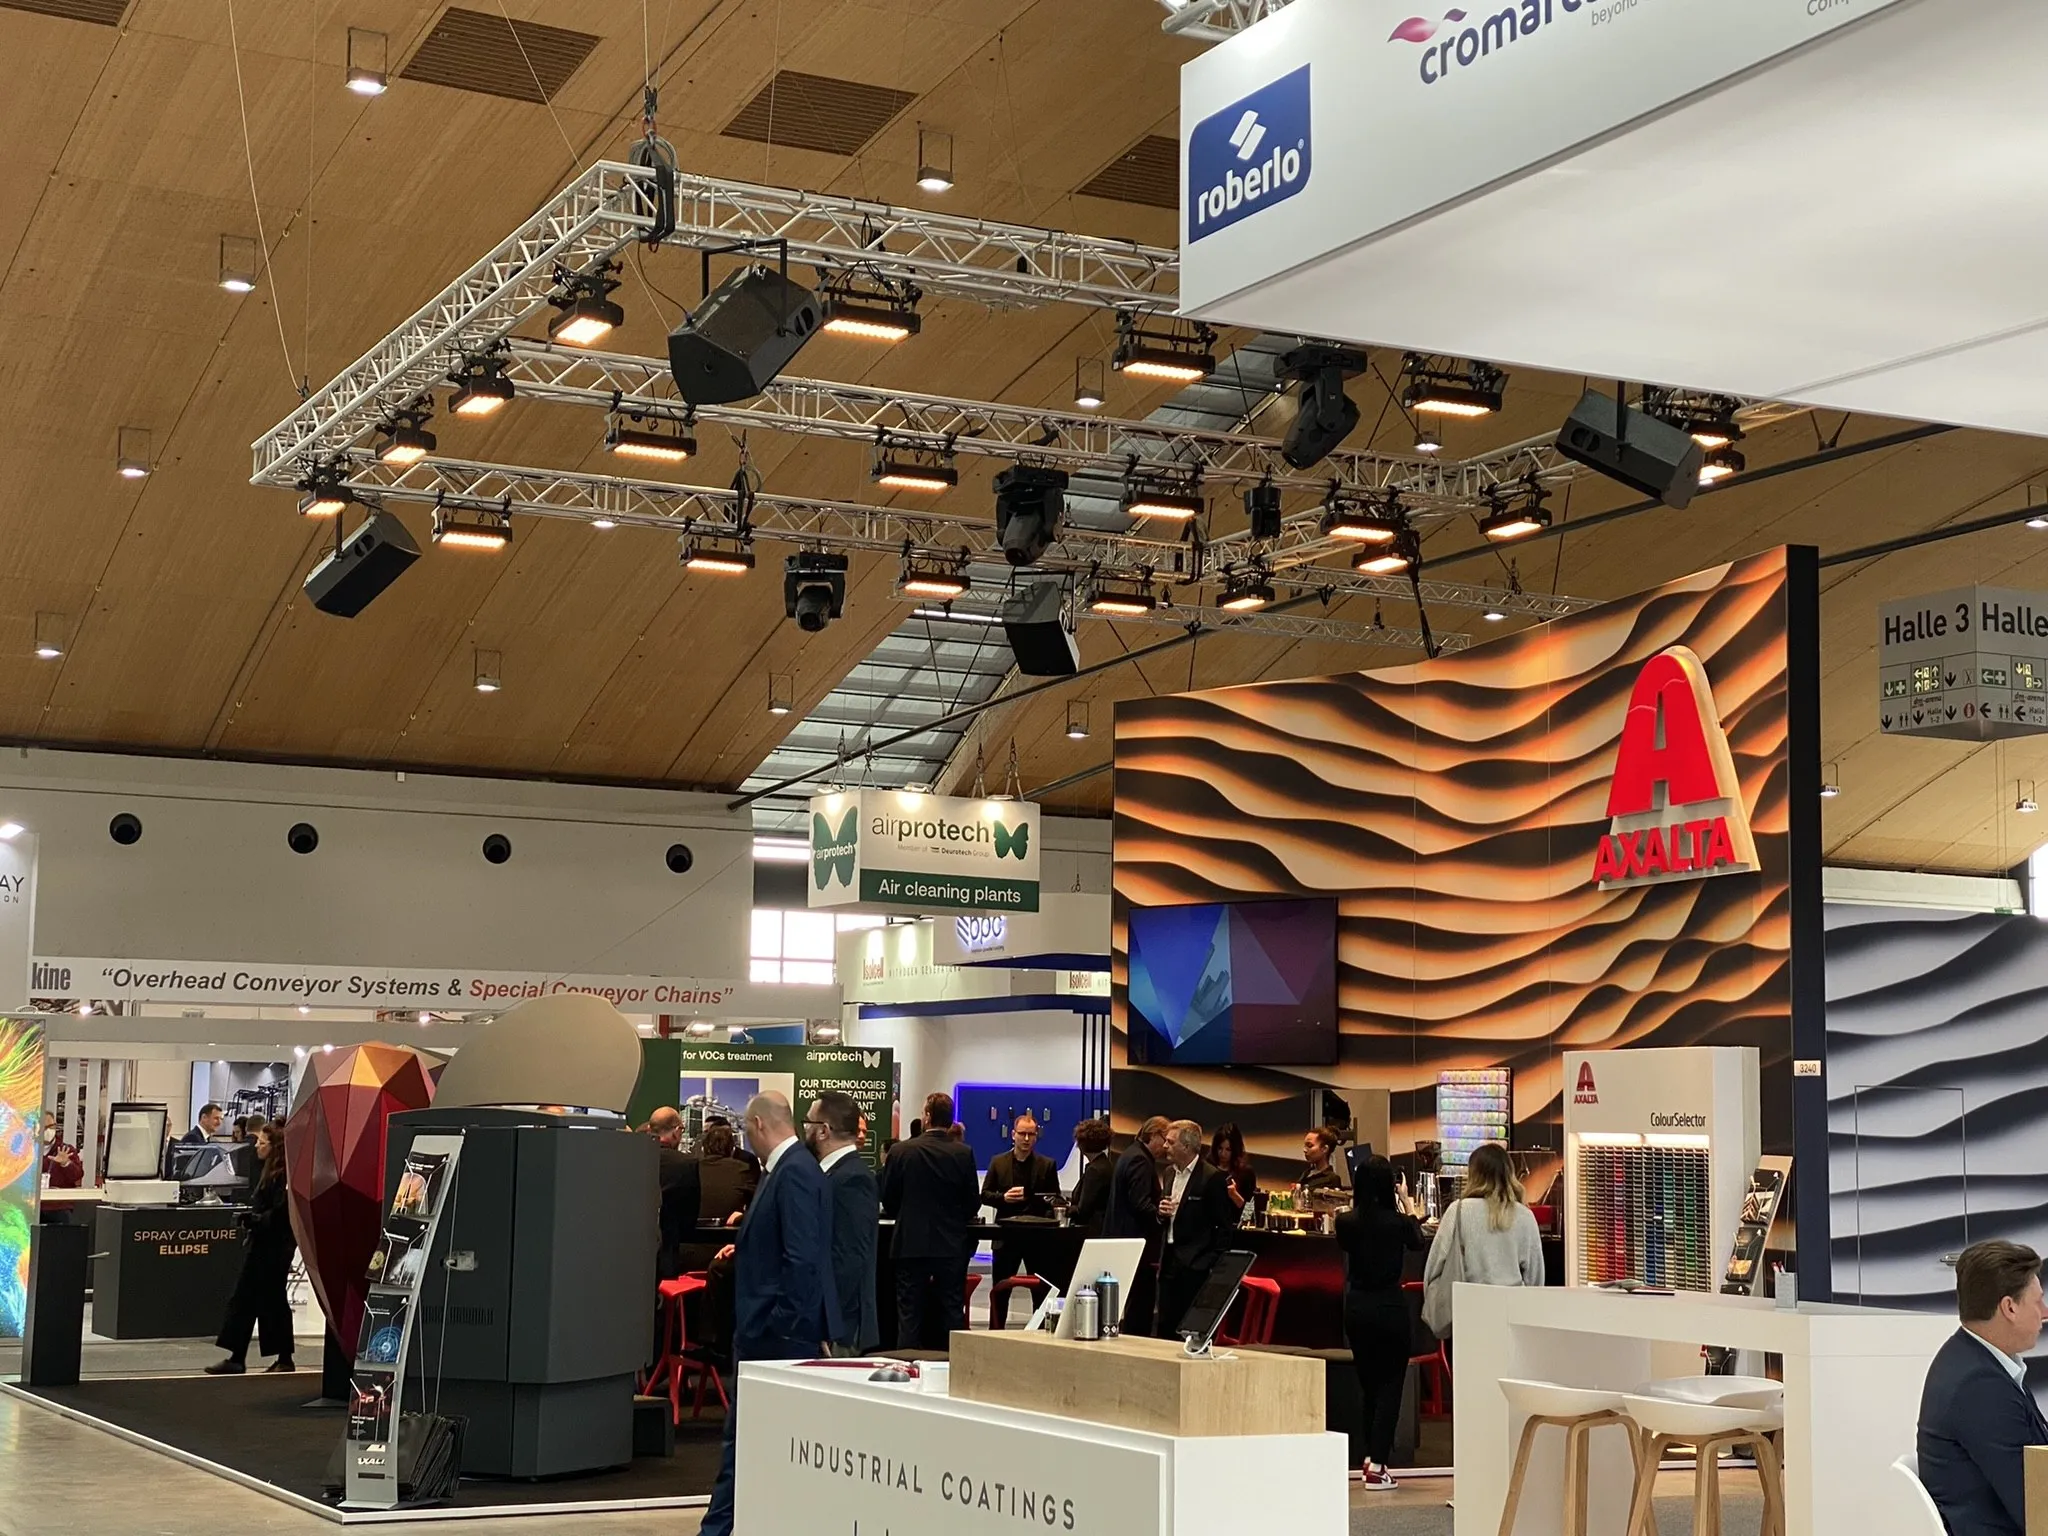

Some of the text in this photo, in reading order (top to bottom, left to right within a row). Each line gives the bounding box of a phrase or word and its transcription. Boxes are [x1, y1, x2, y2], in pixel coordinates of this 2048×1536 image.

[1885, 603, 1969, 645] Halle 3
[1982, 602, 2048, 637] Halle
[872, 813, 990, 843] airprotech
[815, 842, 854, 861] airprotech
[1592, 816, 1737, 884] AXALTA
[878, 878, 1022, 904] Air cleaning plants
[32, 963, 71, 990] kine
[232, 973, 342, 996] Conveyor
[347, 976, 440, 999] Systems
[448, 979, 462, 996] &
[469, 980, 546, 1000] Special
[683, 1051, 772, 1062] for VOCs treatment
[806, 1050, 862, 1063] airprotech
[1800, 1063, 1816, 1074] 3240
[800, 1079, 886, 1090] OUR TECHNOLOGIES
[799, 1090, 816, 1099] FOR
[1573, 1094, 1598, 1104] AXALTA
[1650, 1112, 1706, 1127] ColourSelector
[134, 1229, 237, 1241] SPRAY CAPTURE
[160, 1244, 209, 1255] ELLIPSE
[790, 1437, 1075, 1530] INDUSTRIAL COATINGS
